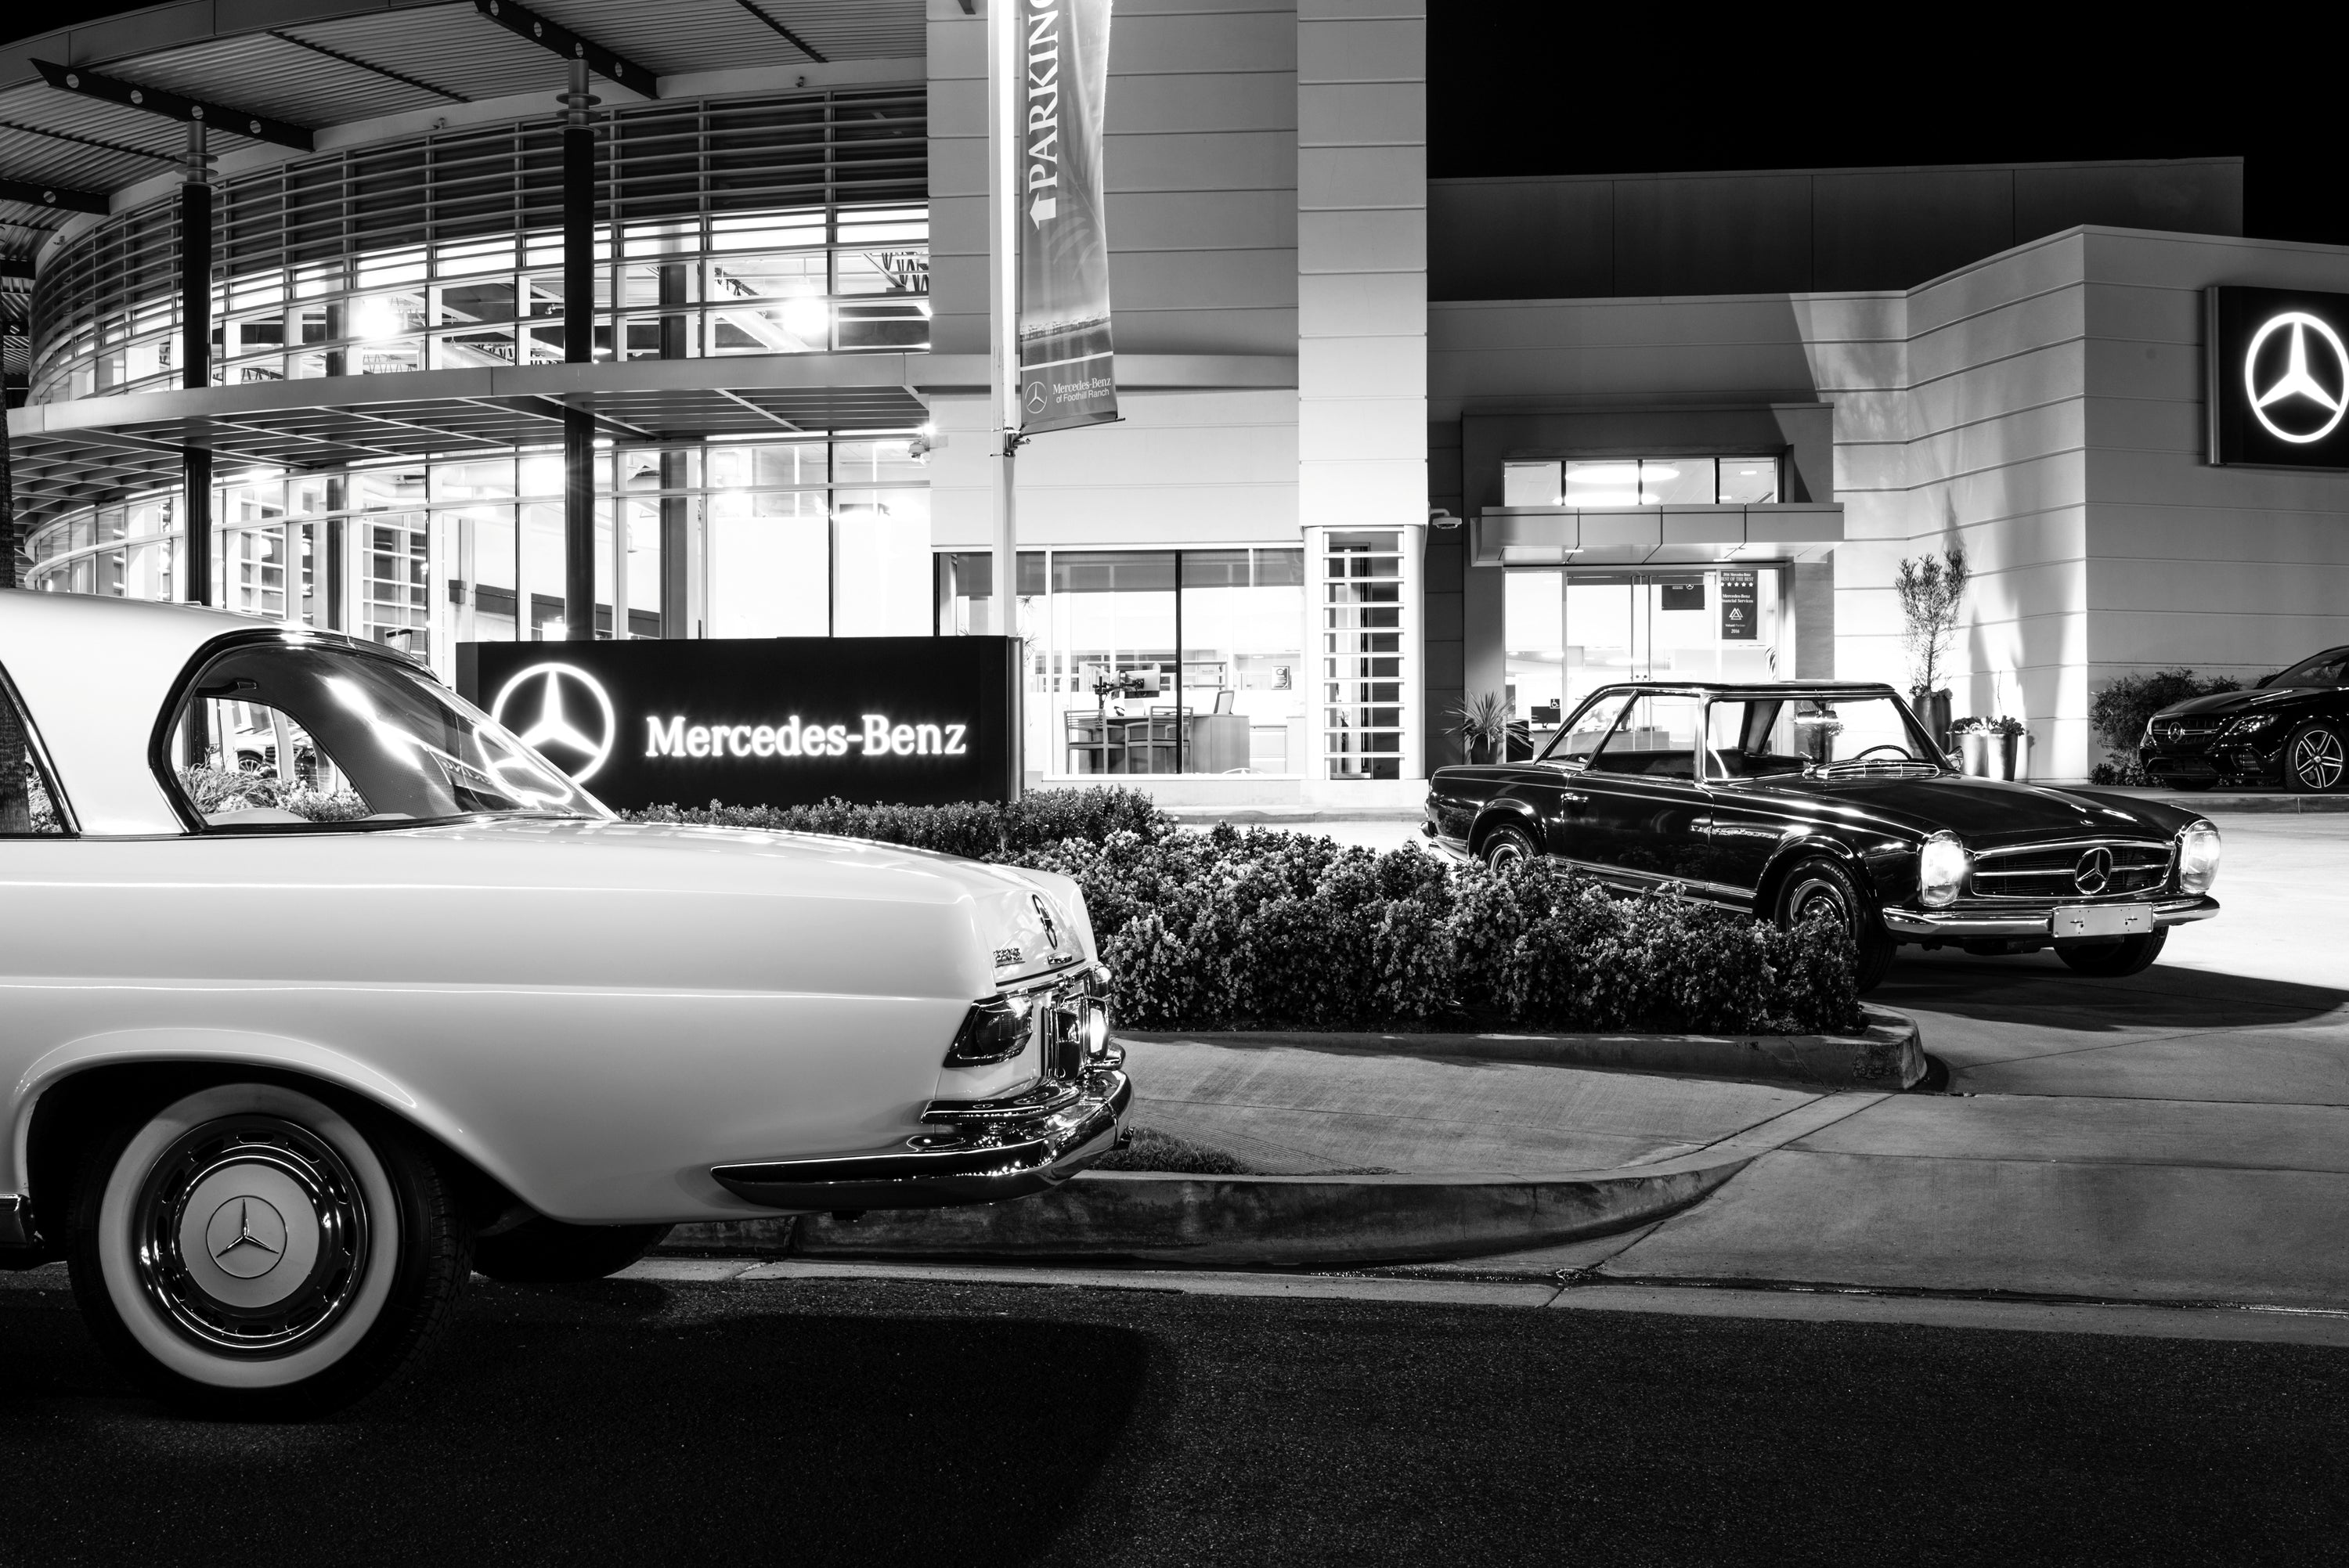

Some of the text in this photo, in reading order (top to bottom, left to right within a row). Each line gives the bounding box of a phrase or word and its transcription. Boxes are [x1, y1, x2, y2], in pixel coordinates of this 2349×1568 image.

[1028, 0, 1058, 193] PARKIN
[1052, 377, 1111, 395] Mercedes-Benz
[1056, 387, 1110, 403] of Foothill Ranch
[645, 714, 966, 757] Mercedes-Benz
